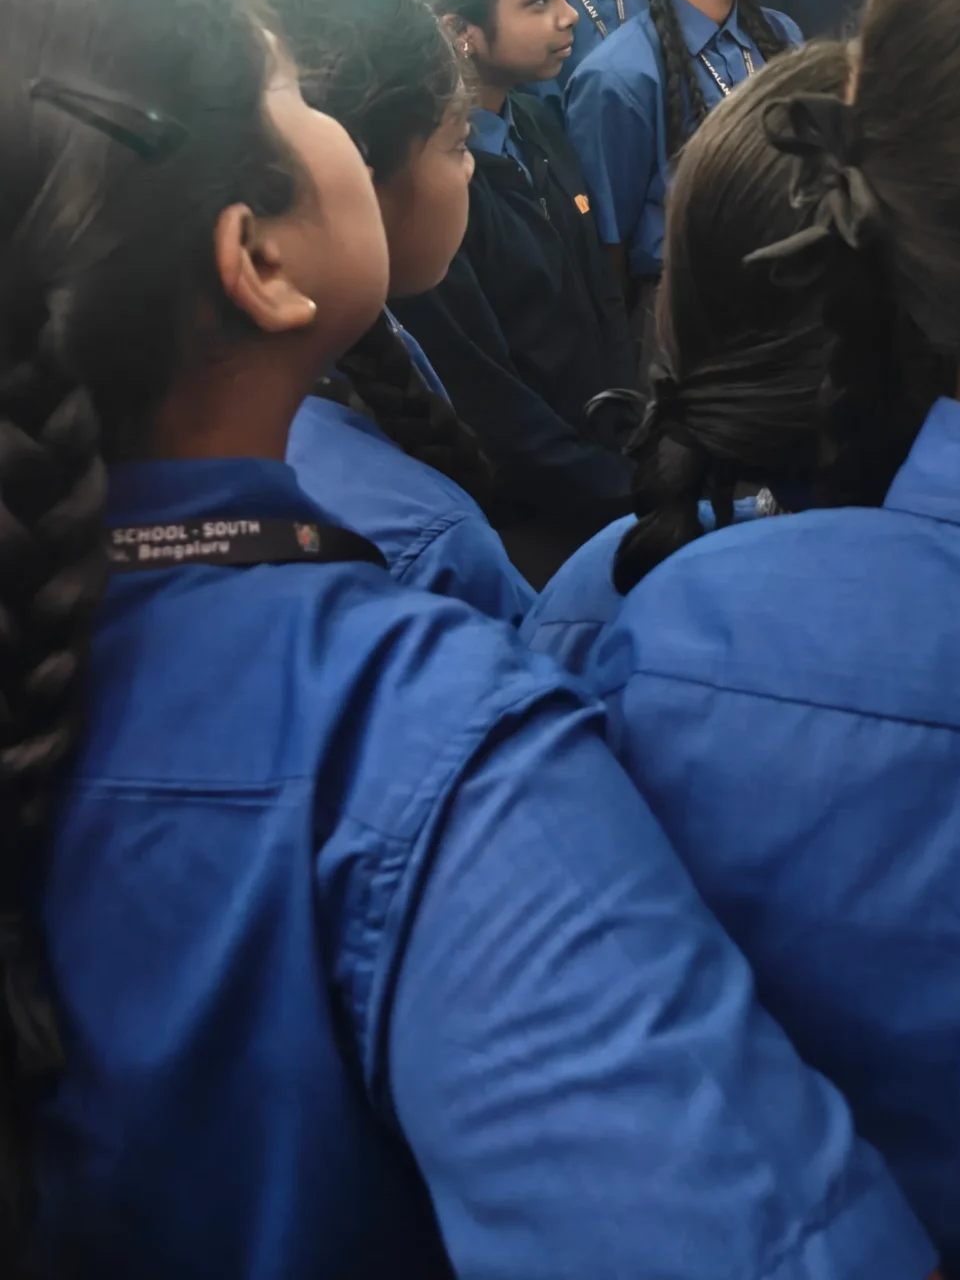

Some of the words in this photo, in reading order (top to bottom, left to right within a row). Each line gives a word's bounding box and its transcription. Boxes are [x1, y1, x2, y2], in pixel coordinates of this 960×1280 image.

[112, 525, 188, 544] SCHOOL
[203, 521, 260, 538] SOUTH
[138, 540, 230, 560] Bengaluru
